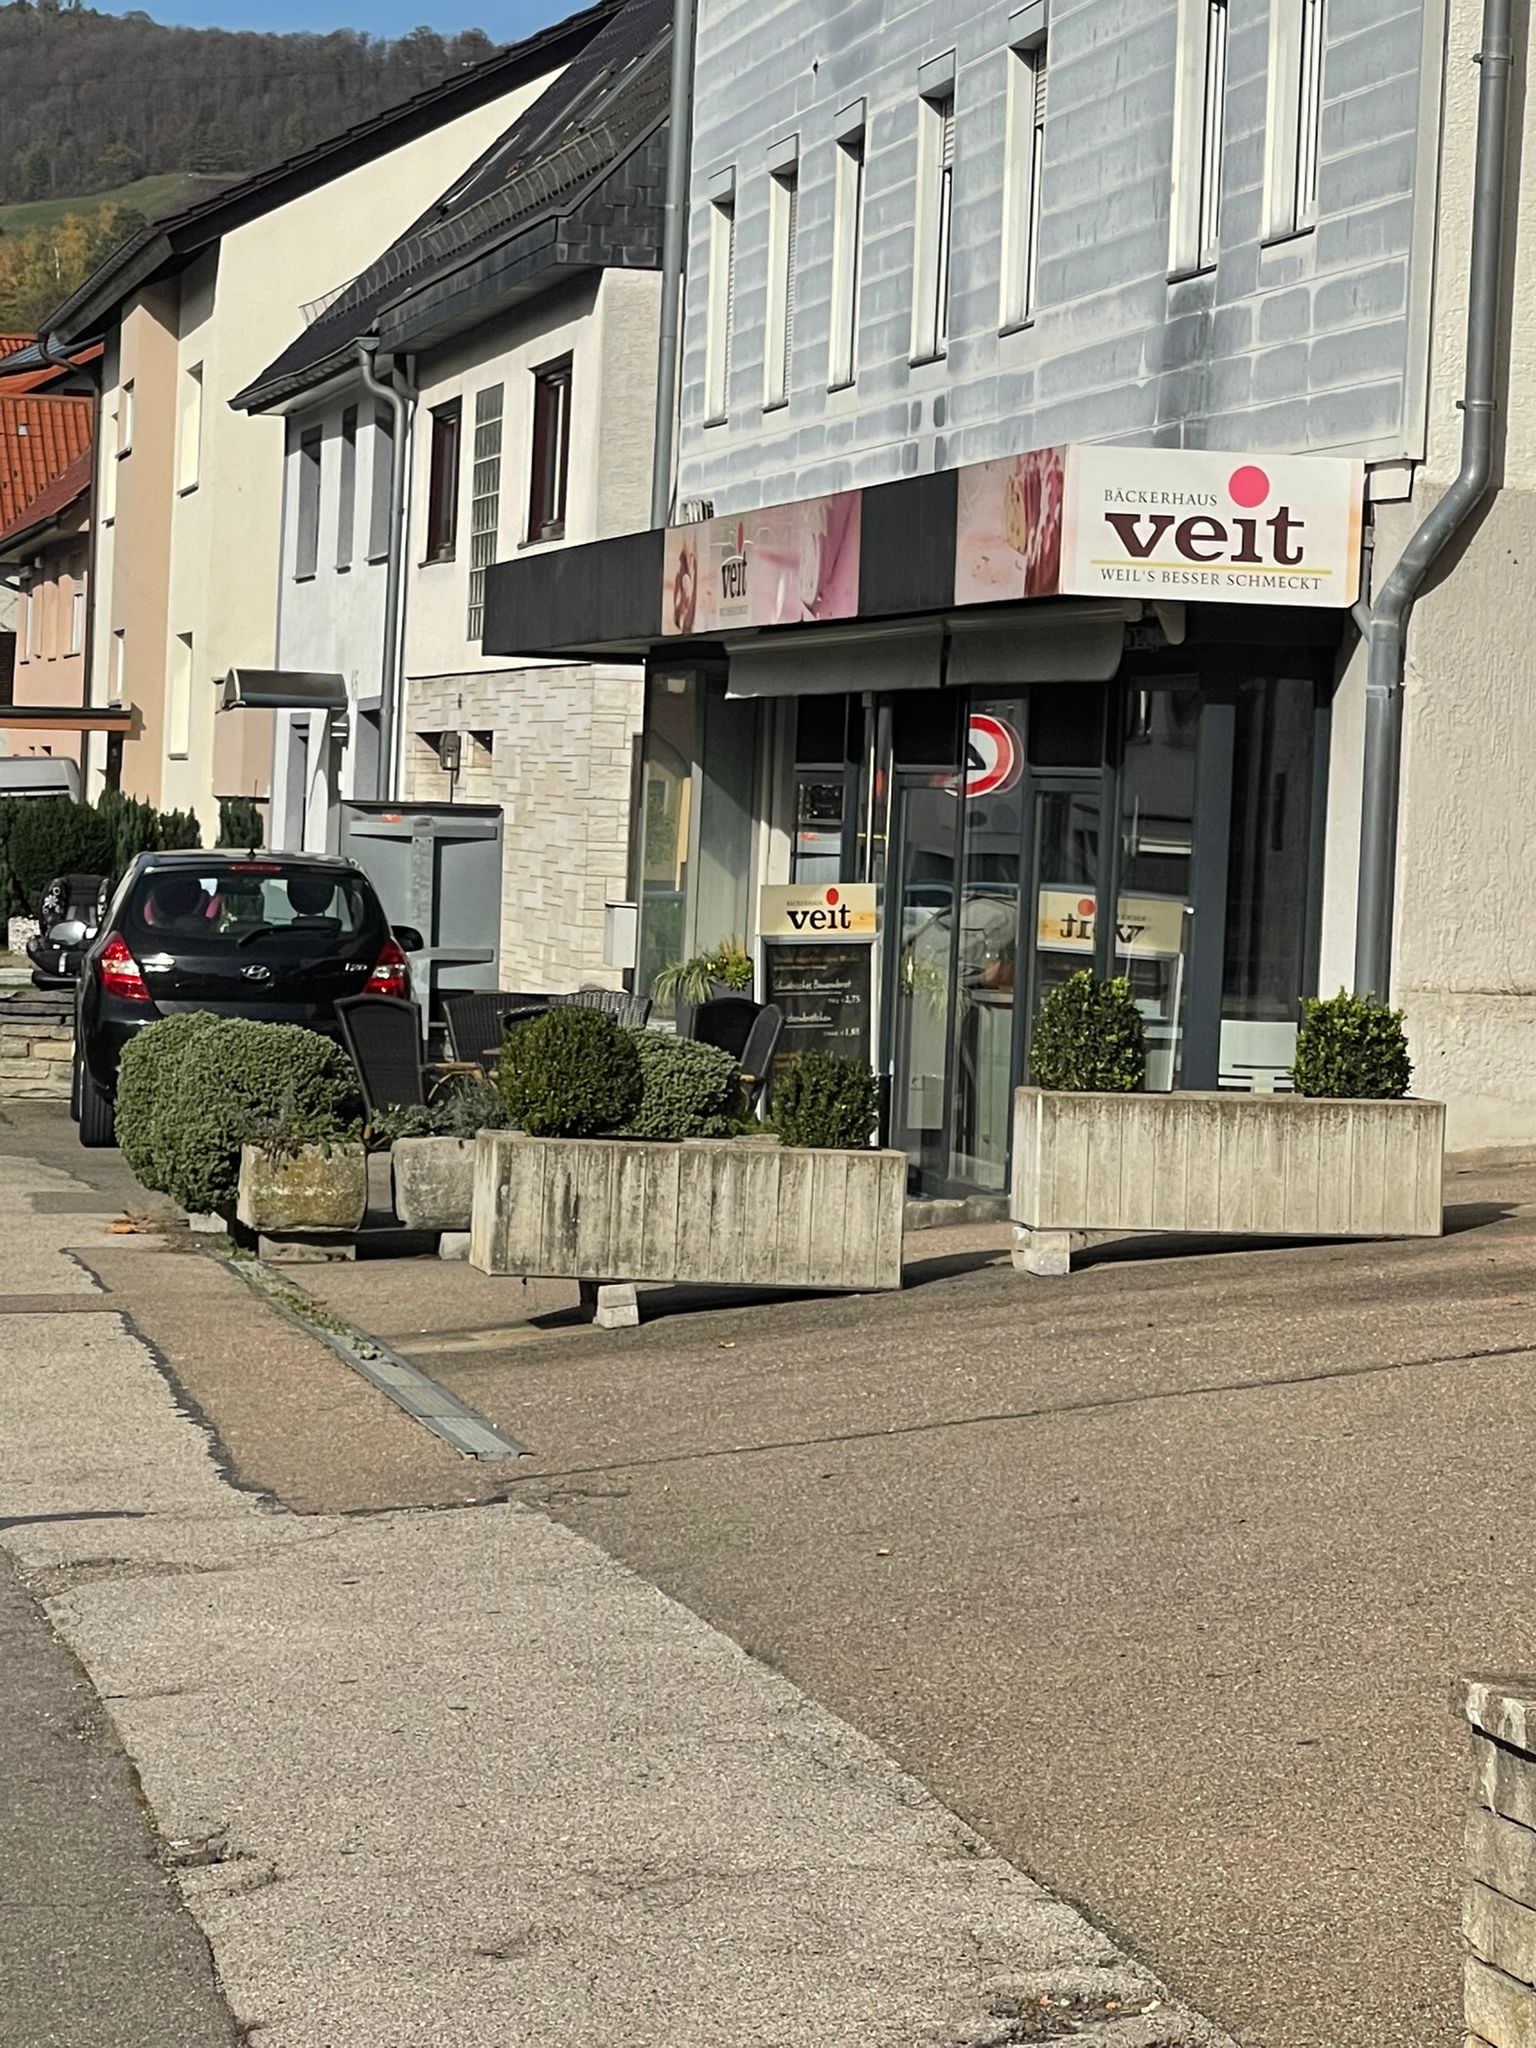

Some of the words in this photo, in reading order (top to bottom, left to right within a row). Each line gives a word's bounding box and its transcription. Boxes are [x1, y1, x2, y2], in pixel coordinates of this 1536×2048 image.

[1104, 488, 1218, 507] BÄCKERHAUS
[1104, 465, 1306, 566] veit
[721, 521, 748, 600] veit
[1100, 568, 1156, 584] WEIL'S
[1161, 573, 1221, 588] BESSER
[1226, 575, 1322, 590] SCHMECKT
[786, 887, 852, 930] veit
